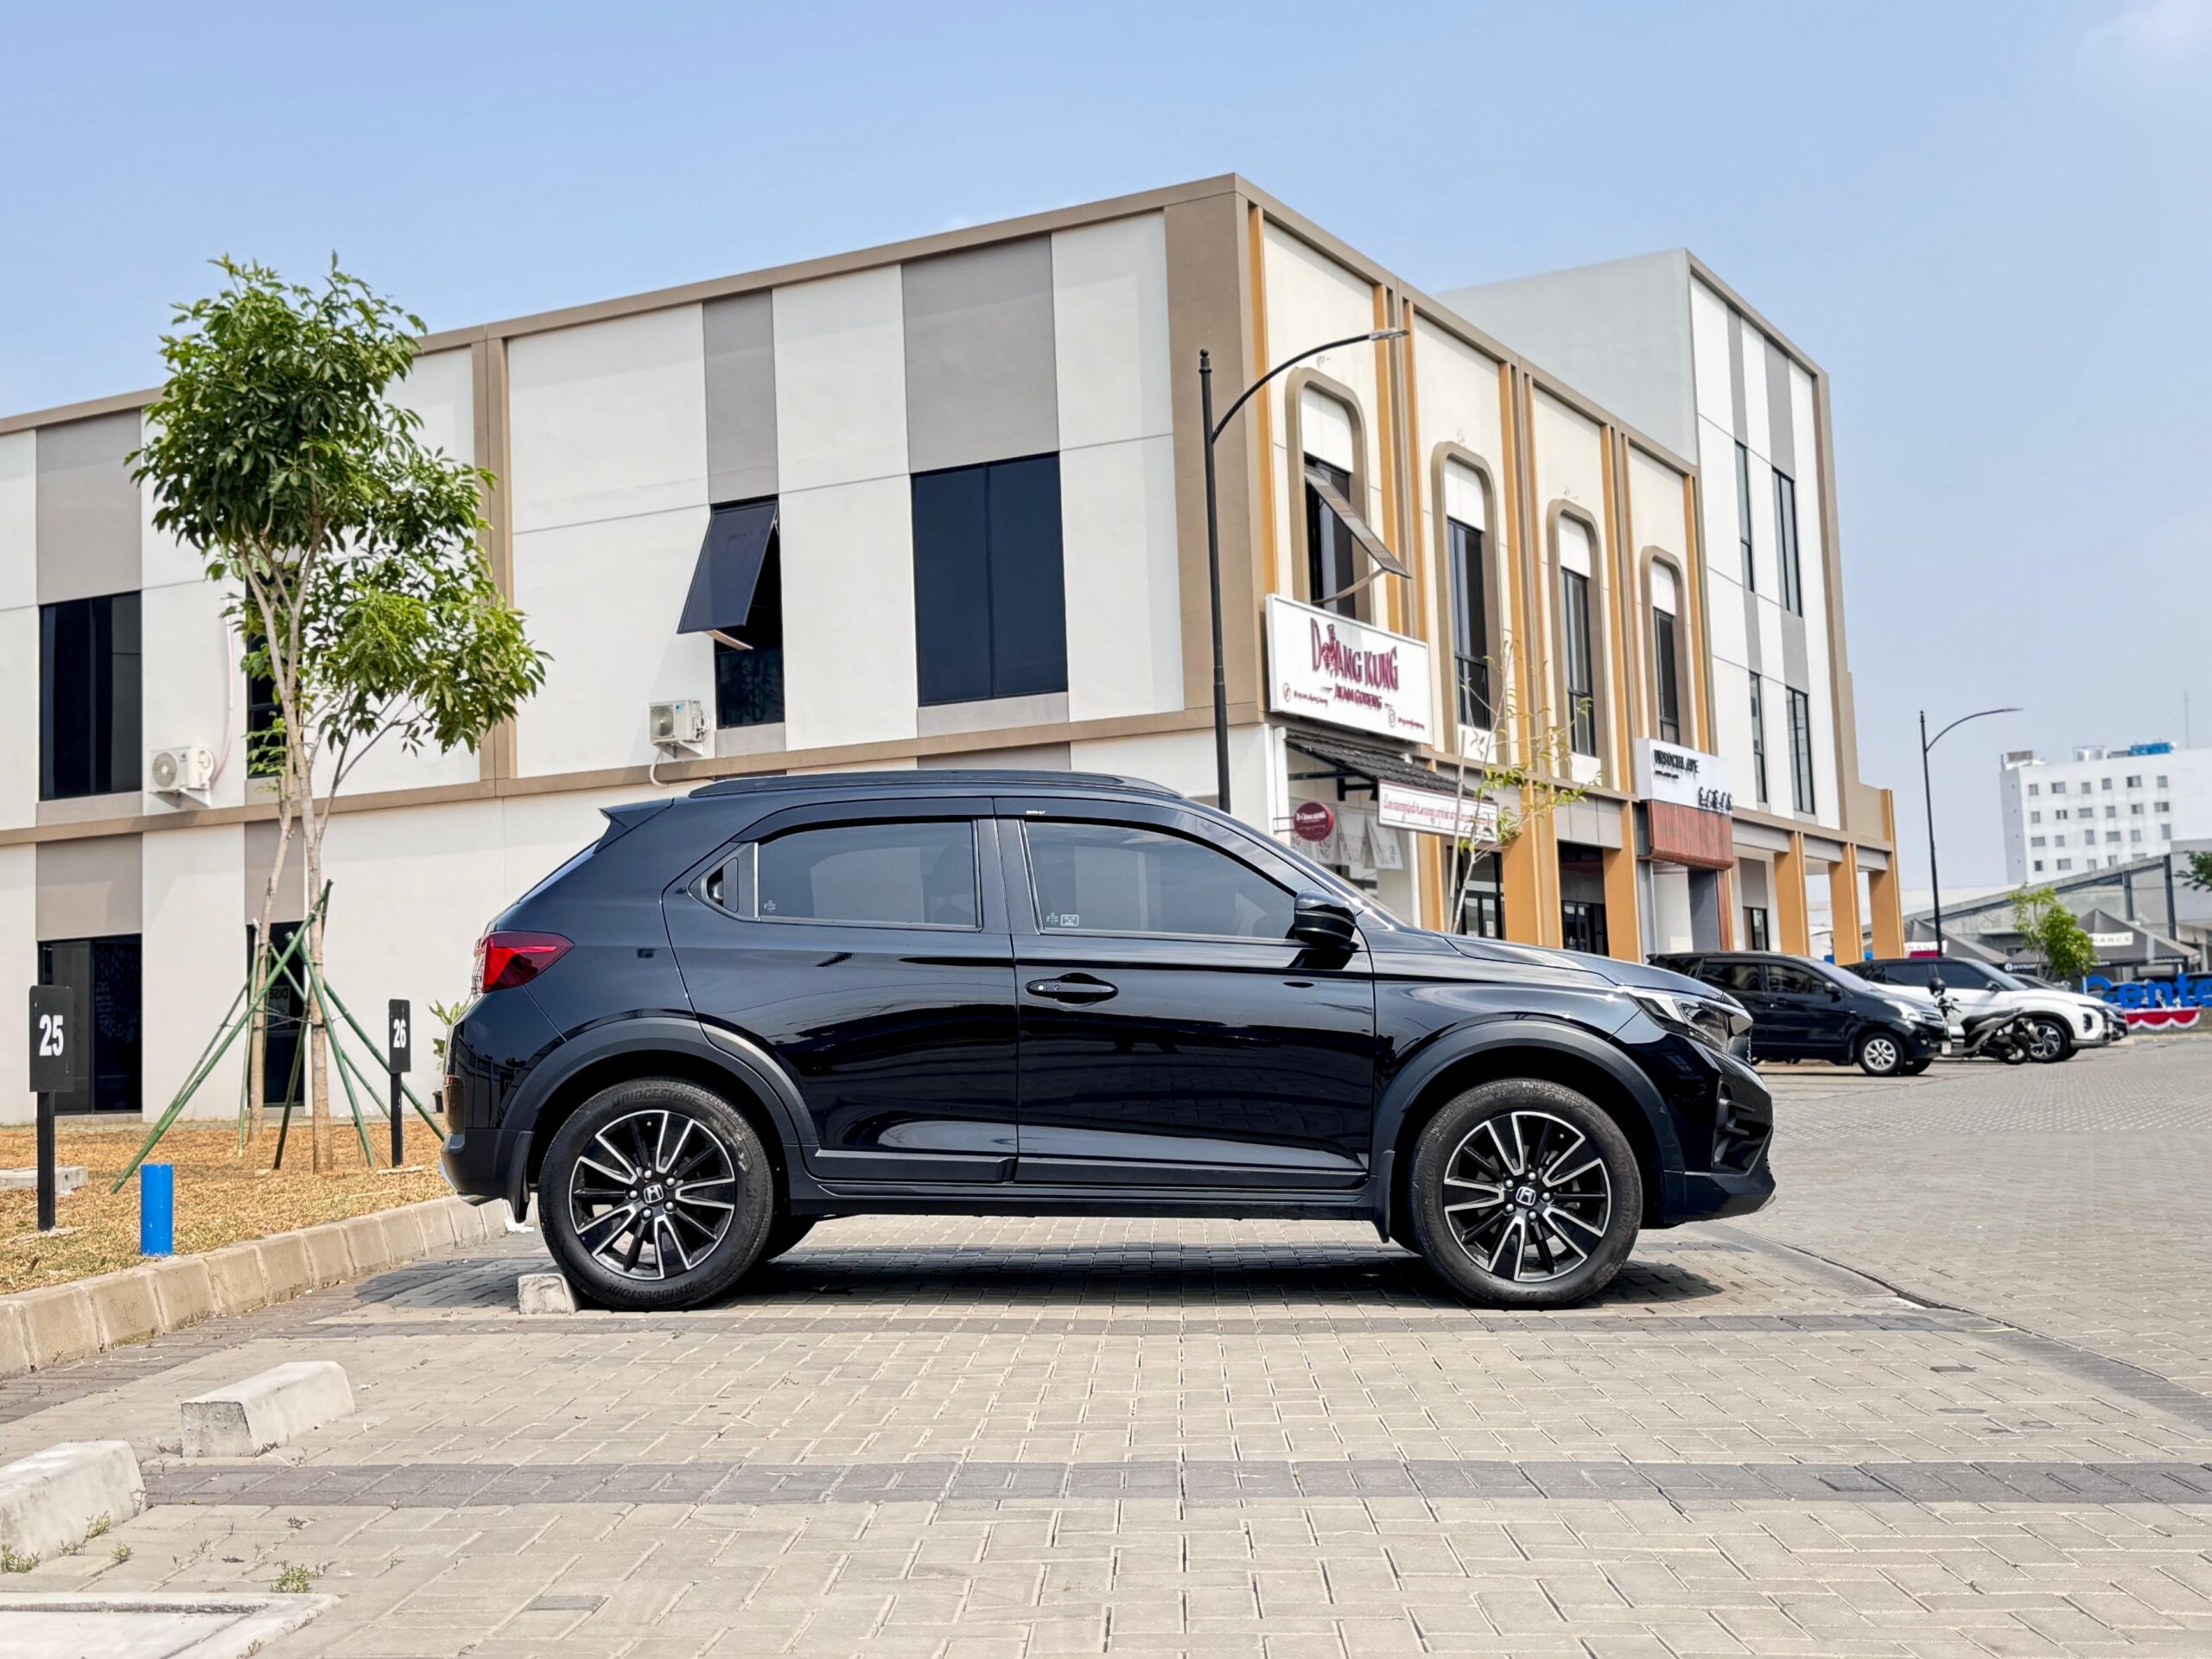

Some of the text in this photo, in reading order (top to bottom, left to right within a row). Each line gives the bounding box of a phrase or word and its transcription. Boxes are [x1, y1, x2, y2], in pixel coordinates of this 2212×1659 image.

[1363, 645, 1400, 690] KUNG
[39, 1014, 65, 1057] 25
[392, 1018, 407, 1049] 26
[612, 1088, 700, 1108] BRIDGESTONE
